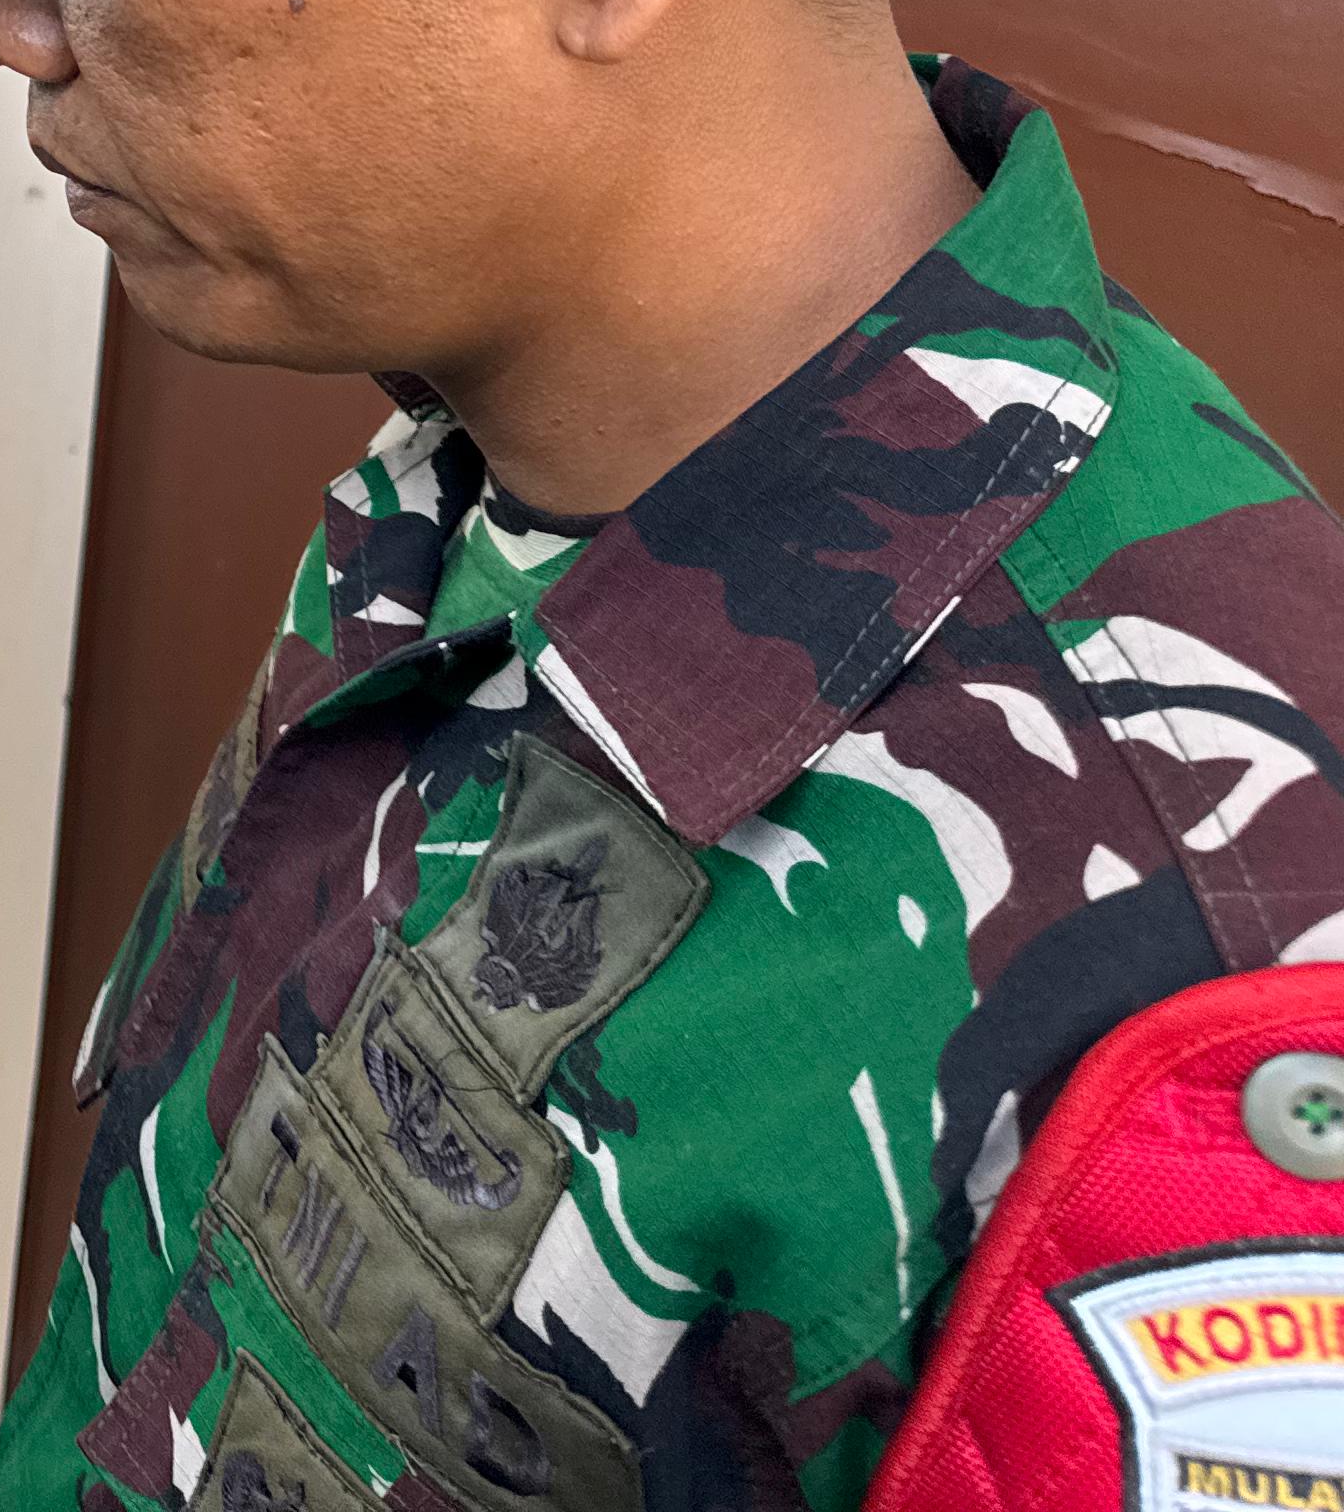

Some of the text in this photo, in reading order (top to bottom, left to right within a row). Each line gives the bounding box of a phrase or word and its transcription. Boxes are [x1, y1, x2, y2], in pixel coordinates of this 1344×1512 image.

[260, 1110, 552, 1496] TNI AD
[1141, 1301, 1344, 1374] KODI
[1186, 1460, 1344, 1512] MULA
